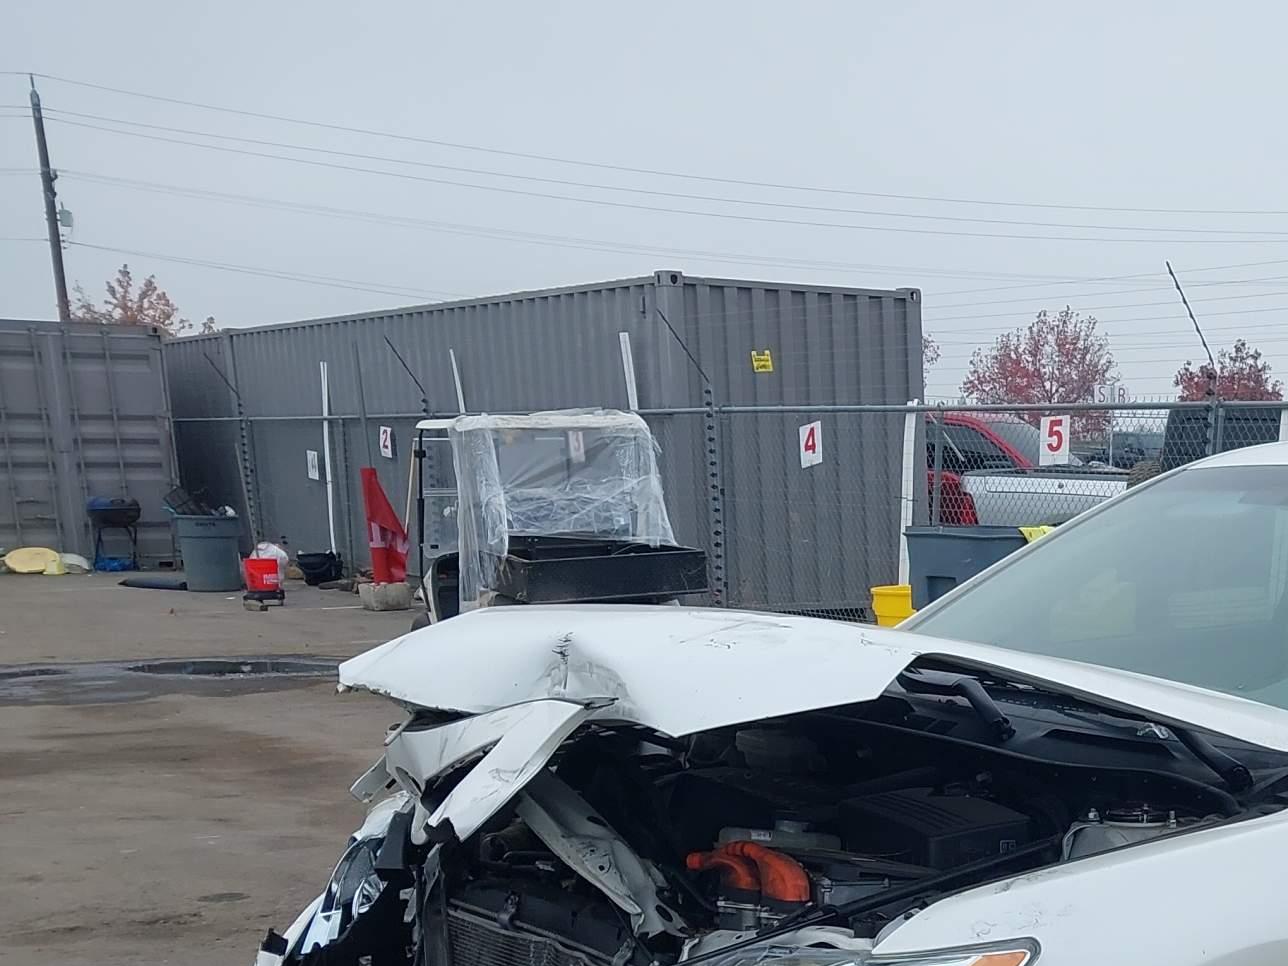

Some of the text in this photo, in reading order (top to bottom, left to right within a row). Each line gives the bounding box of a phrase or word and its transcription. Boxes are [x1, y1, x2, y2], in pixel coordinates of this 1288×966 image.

[382, 429, 389, 449] 2
[804, 426, 817, 454] 4
[1047, 418, 1063, 453] 5
